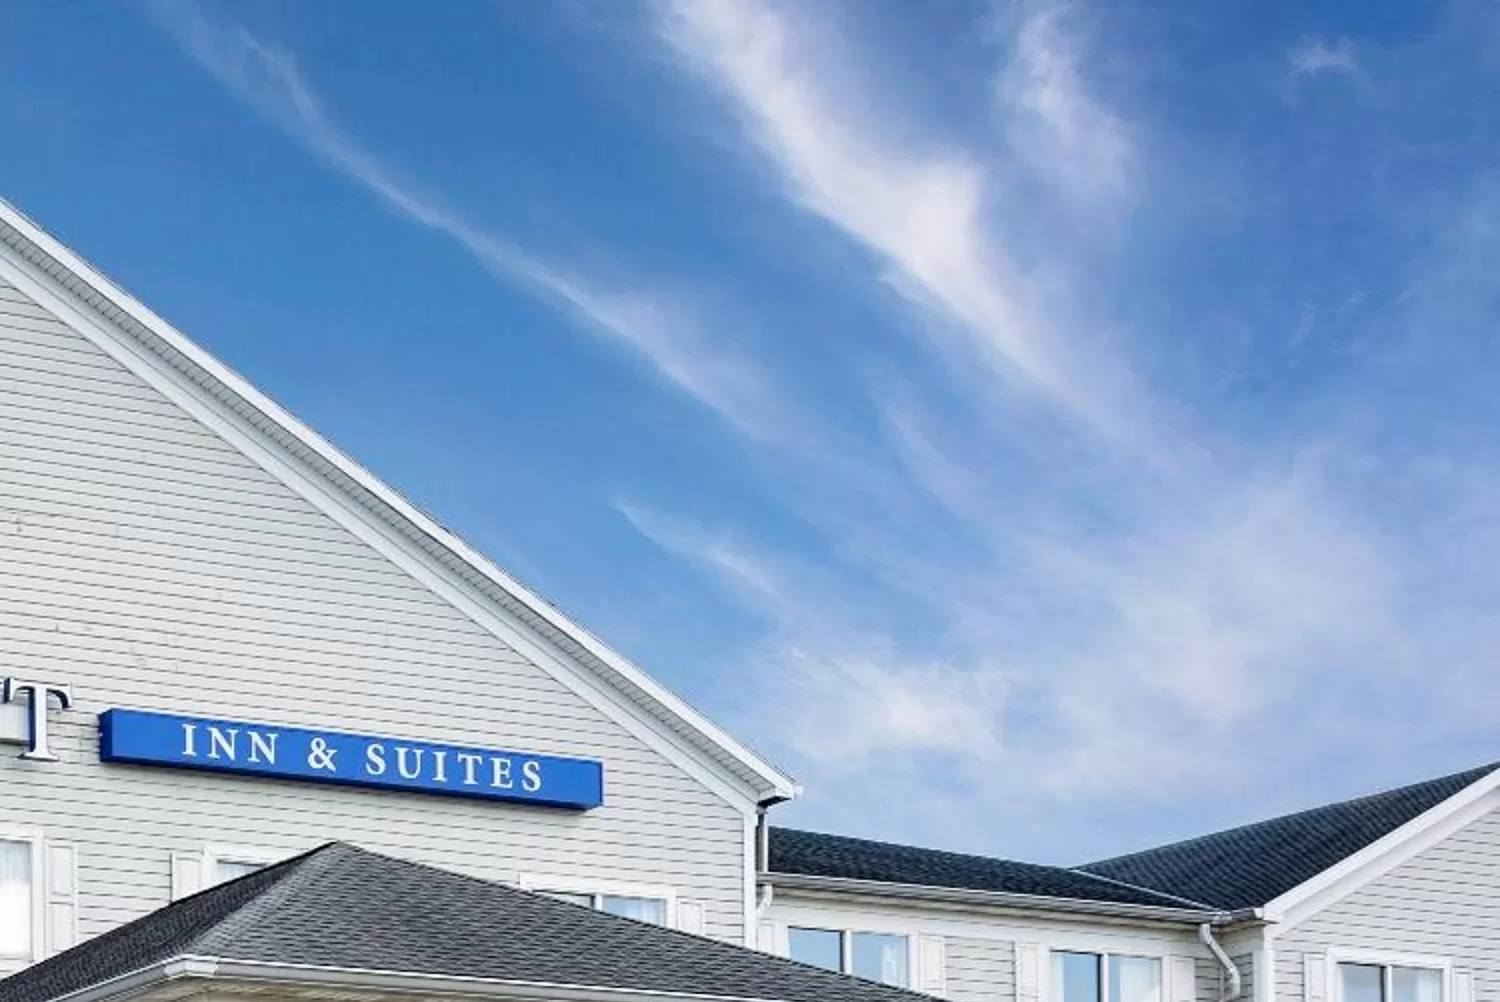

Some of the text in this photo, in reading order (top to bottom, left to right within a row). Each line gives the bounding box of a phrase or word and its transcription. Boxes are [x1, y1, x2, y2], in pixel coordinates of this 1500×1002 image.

[182, 724, 542, 792] INN & SUITES
